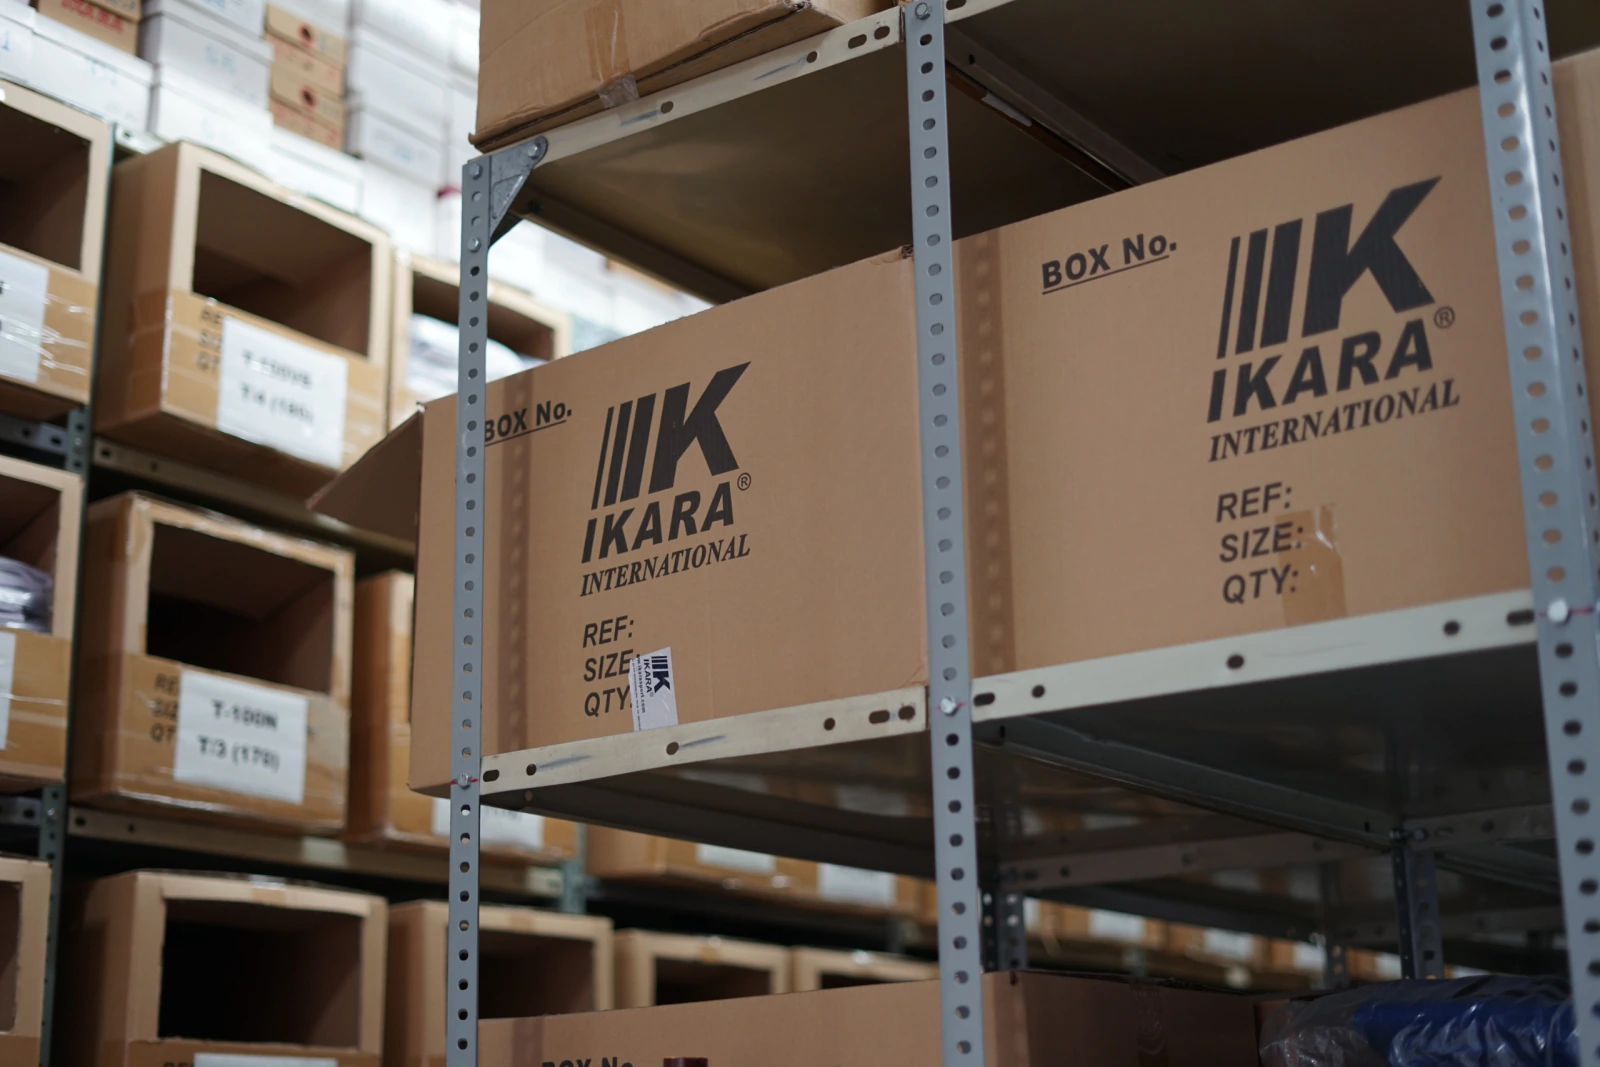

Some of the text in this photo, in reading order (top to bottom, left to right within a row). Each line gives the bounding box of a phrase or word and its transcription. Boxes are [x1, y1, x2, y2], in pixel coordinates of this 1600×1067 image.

[1042, 233, 1177, 289] BOX No.
[1206, 318, 1434, 423] IKARA
[485, 400, 572, 442] BOX No.
[1208, 379, 1460, 462] INTERNATIONAL
[581, 481, 734, 564] IKARA
[1216, 482, 1292, 523] REF:
[1219, 521, 1303, 563] SIZE:
[579, 534, 751, 597] INTERNATIONAL
[1222, 564, 1299, 604] QTY:
[582, 615, 634, 648] REF:
[643, 659, 653, 693] IKARA
[584, 684, 633, 717] QTY
